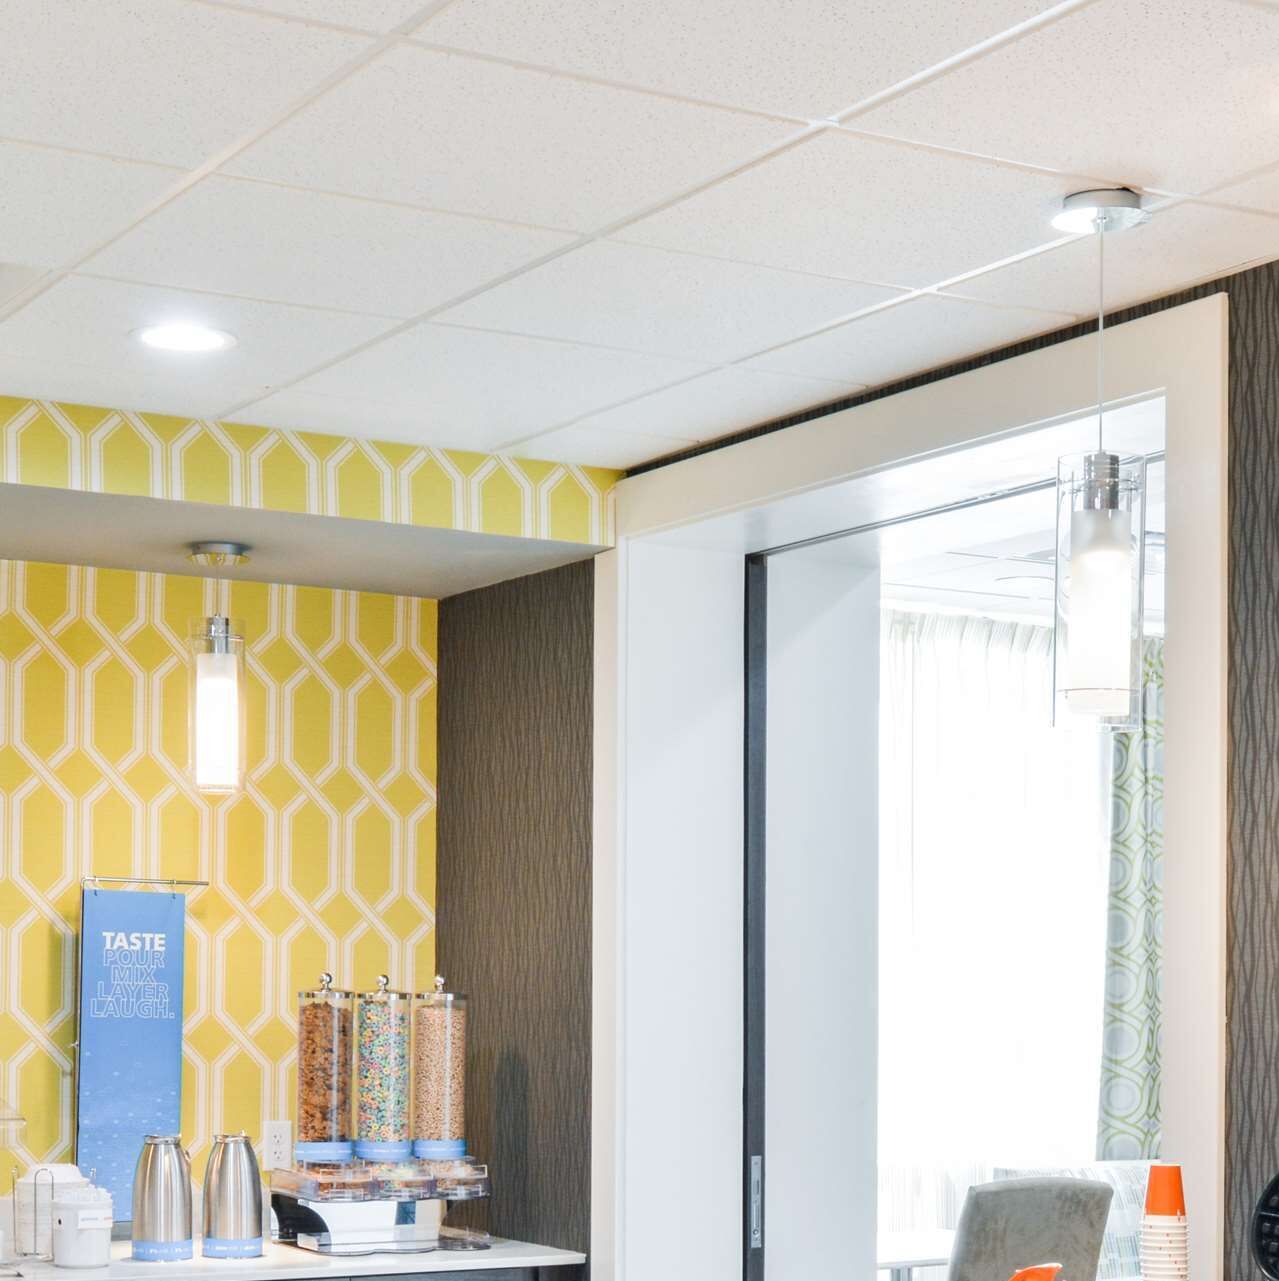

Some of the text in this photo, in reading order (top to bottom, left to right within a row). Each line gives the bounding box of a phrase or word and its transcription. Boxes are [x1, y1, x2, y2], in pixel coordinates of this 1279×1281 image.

[102, 932, 166, 951] TASTE
[103, 948, 166, 968] POUR
[111, 965, 157, 984] MIX
[97, 981, 169, 1000] LAYER
[90, 998, 176, 1019] LAUGH.
